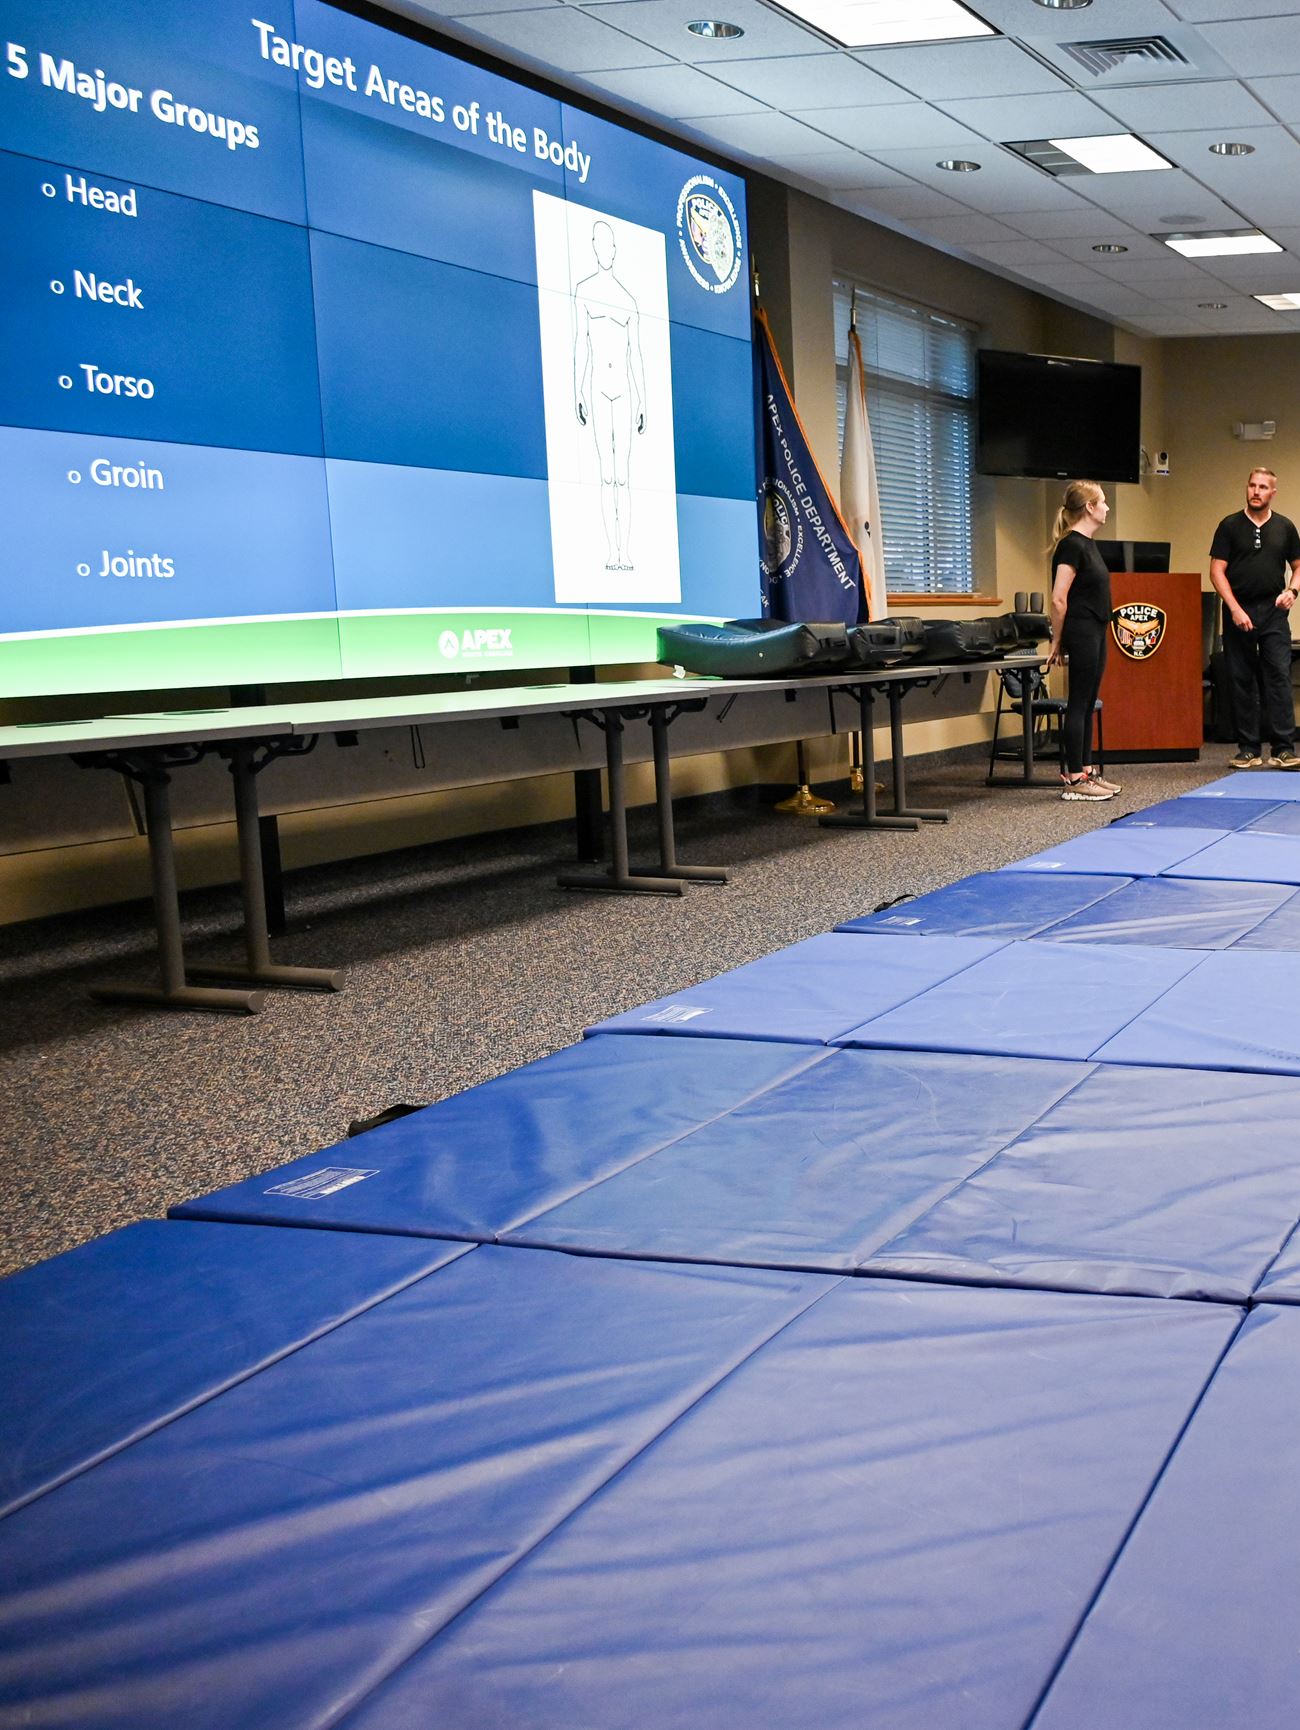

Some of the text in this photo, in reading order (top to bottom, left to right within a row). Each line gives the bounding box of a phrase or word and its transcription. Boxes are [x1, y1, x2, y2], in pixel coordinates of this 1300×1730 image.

[8, 43, 259, 150] 5 Major Groups
[251, 18, 591, 183] Target Areas of the Body
[66, 174, 137, 217] Head
[74, 270, 144, 309] Neck
[80, 364, 154, 399] Torso
[90, 459, 164, 490] Groin
[767, 393, 856, 590] APEX POLICE DEPARTMENT
[100, 550, 175, 578] Joints
[783, 525, 804, 578] EXCELLENCE
[1120, 606, 1158, 617] POLICE
[461, 629, 513, 650] APEX
